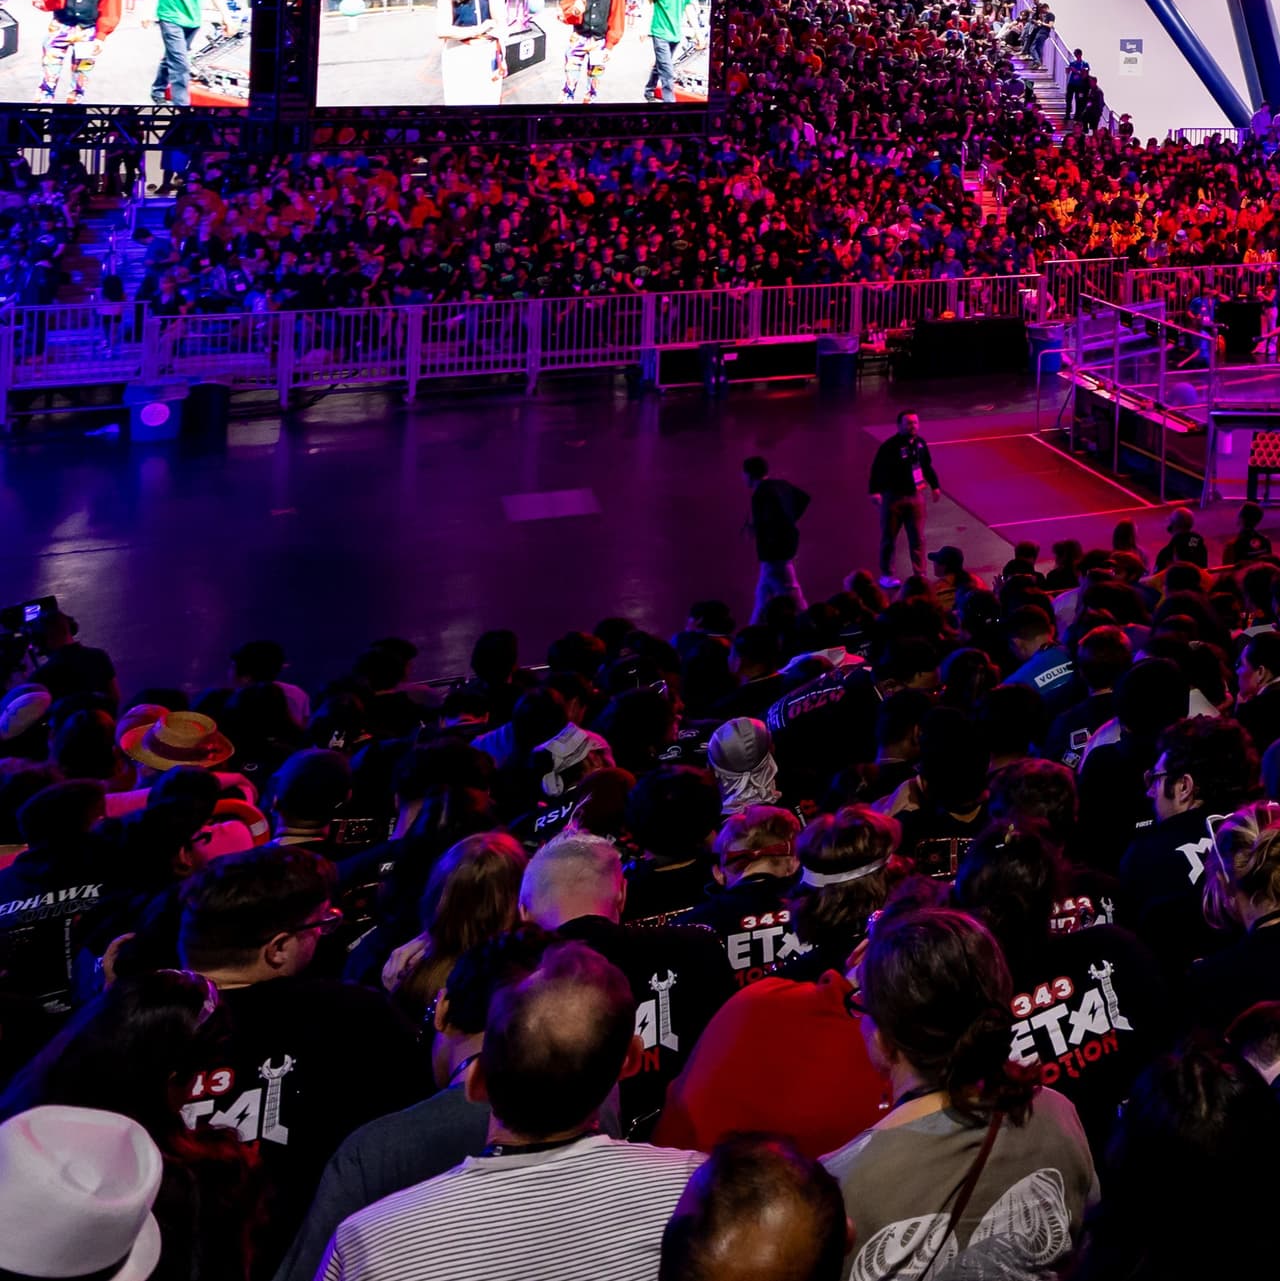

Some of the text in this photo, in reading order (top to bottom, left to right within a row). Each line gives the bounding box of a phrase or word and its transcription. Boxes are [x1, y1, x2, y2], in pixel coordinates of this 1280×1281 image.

[0, 883, 104, 917] EDHAWK
[742, 909, 792, 929] 343
[1008, 959, 1134, 1068] ETAL
[1010, 976, 1074, 1018] 343
[1039, 1029, 1119, 1085] OTION
[178, 1053, 297, 1146] TAL
